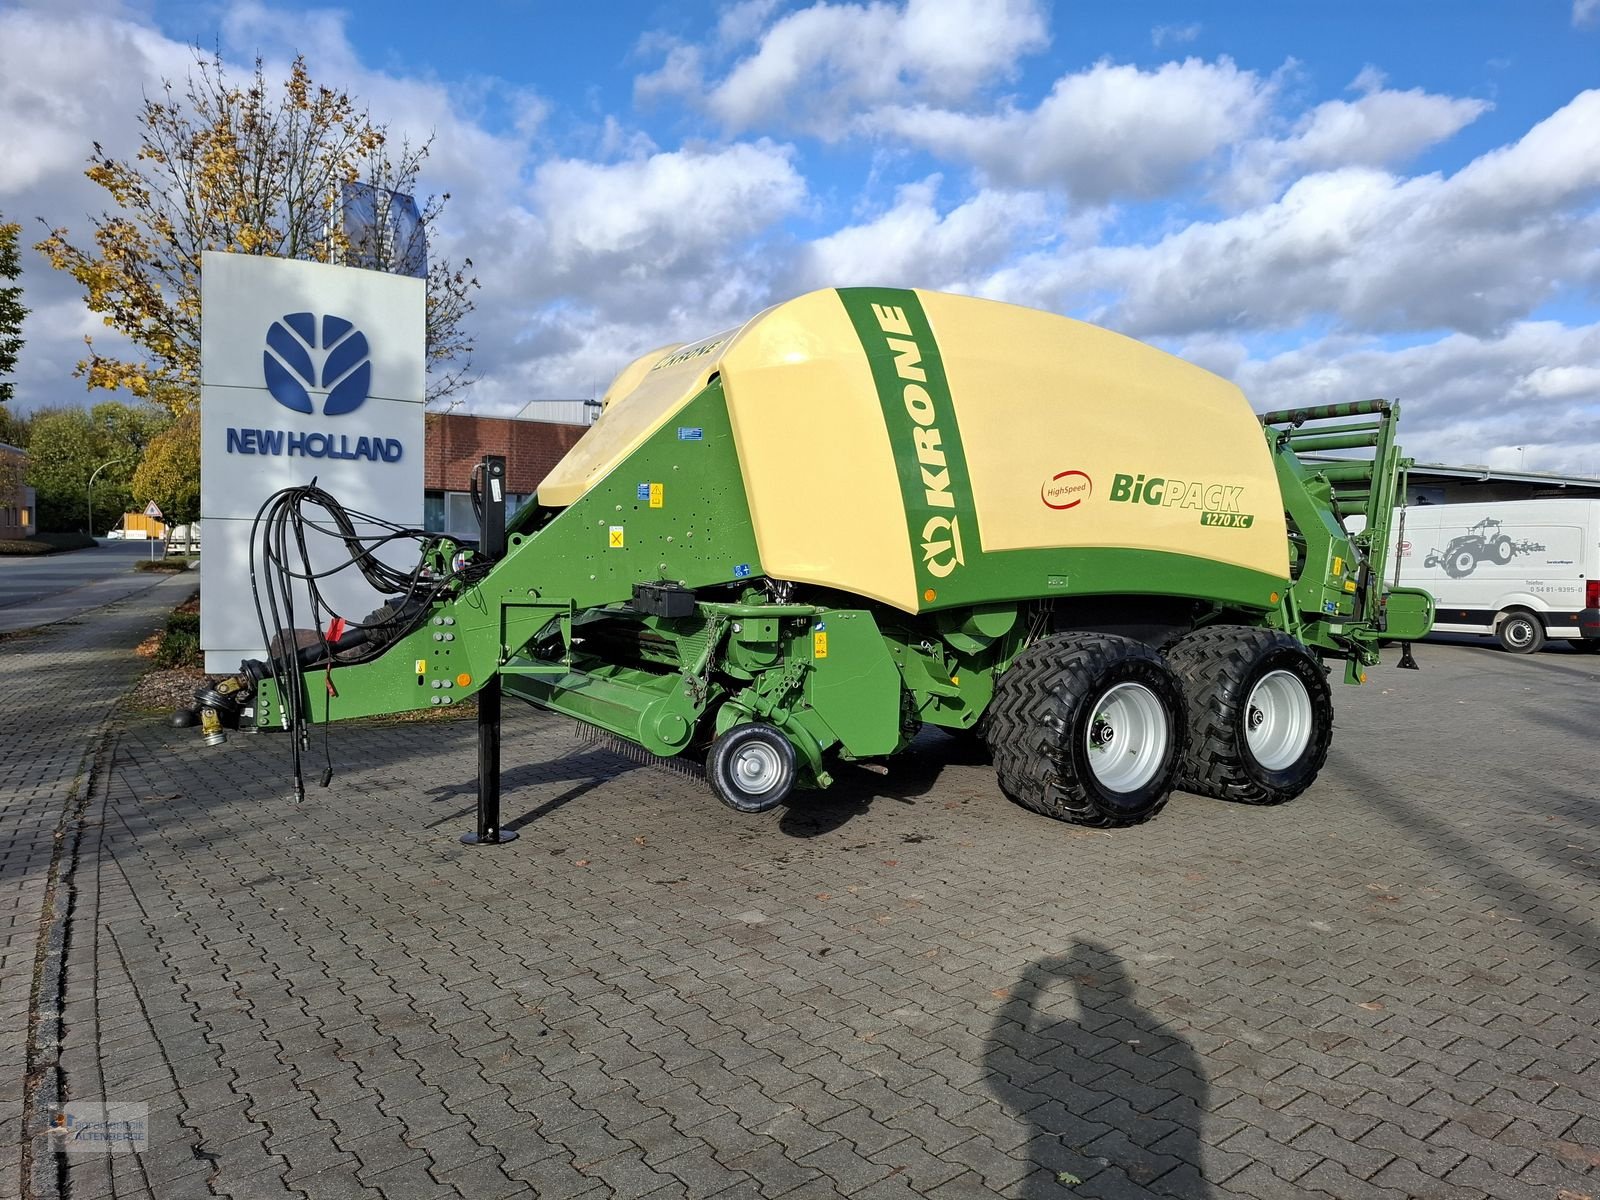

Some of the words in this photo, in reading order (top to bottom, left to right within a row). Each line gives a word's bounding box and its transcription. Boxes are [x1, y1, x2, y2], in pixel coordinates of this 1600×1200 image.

[871, 303, 955, 508] KRONE
[227, 428, 284, 456] NEW
[288, 431, 403, 463] HOLLAND
[1047, 482, 1087, 498] HighSpeed
[1205, 513, 1230, 527] 1270
[1232, 515, 1249, 528] XC
